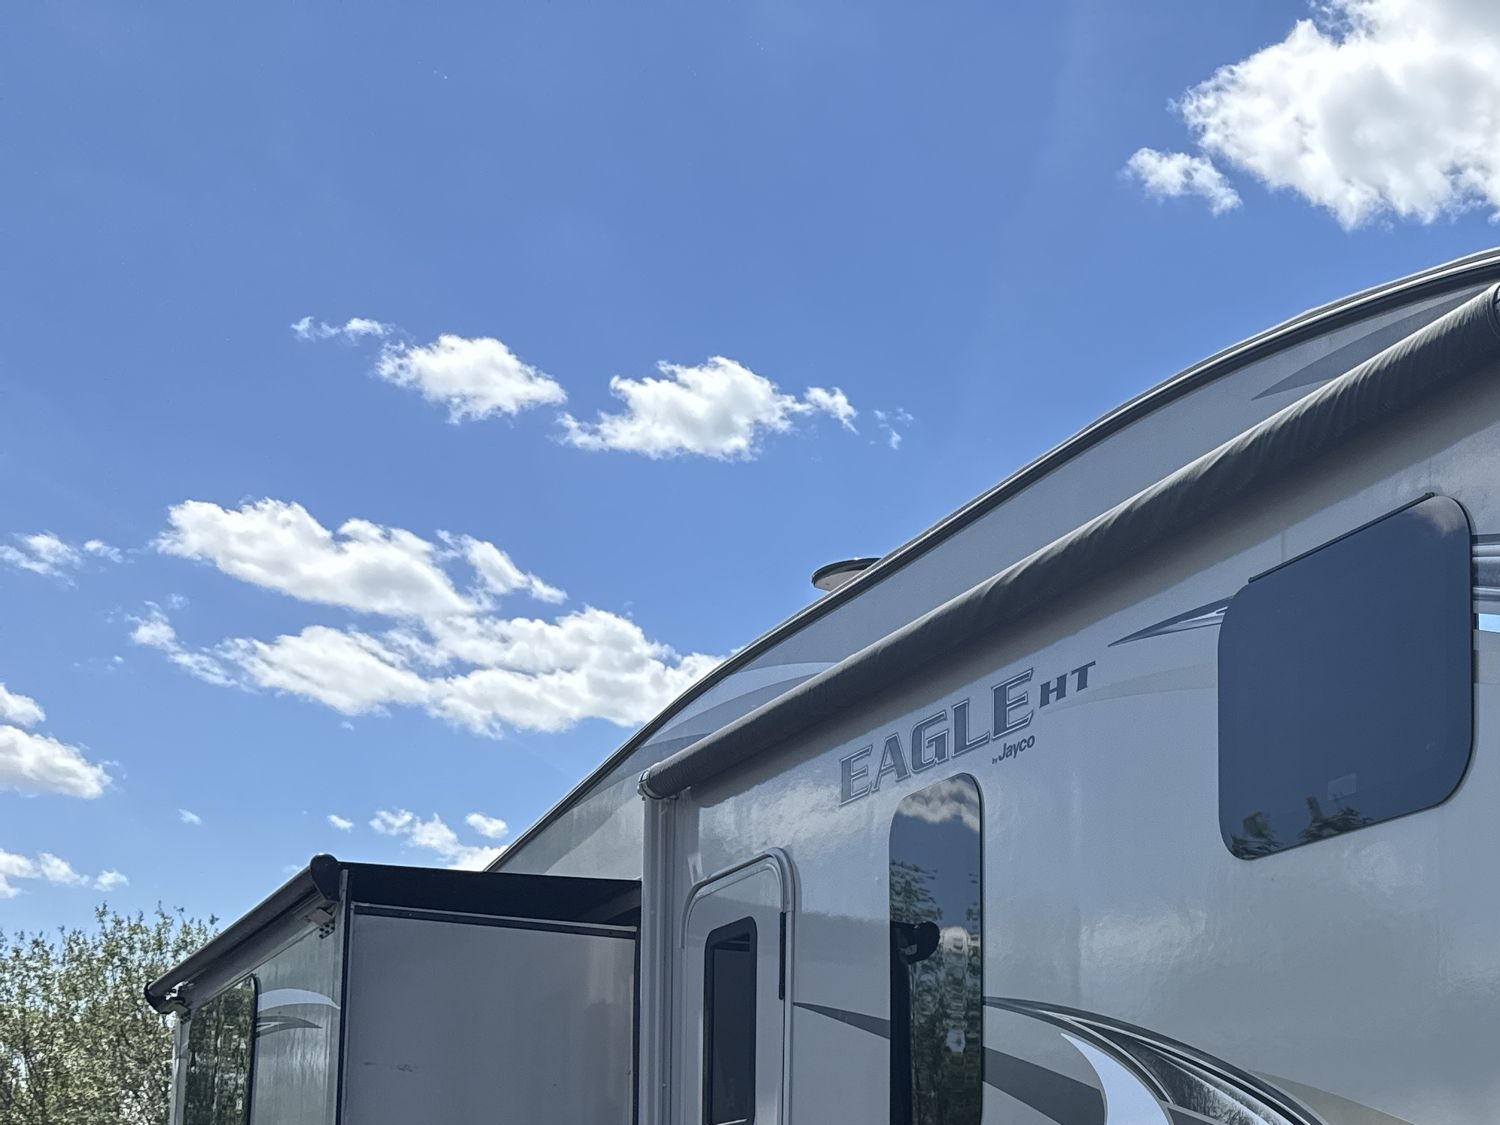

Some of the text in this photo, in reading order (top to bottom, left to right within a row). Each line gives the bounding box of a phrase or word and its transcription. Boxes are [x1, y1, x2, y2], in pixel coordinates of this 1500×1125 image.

[839, 661, 1096, 807] EAGLE HT
[998, 735, 1036, 761] Jayco
